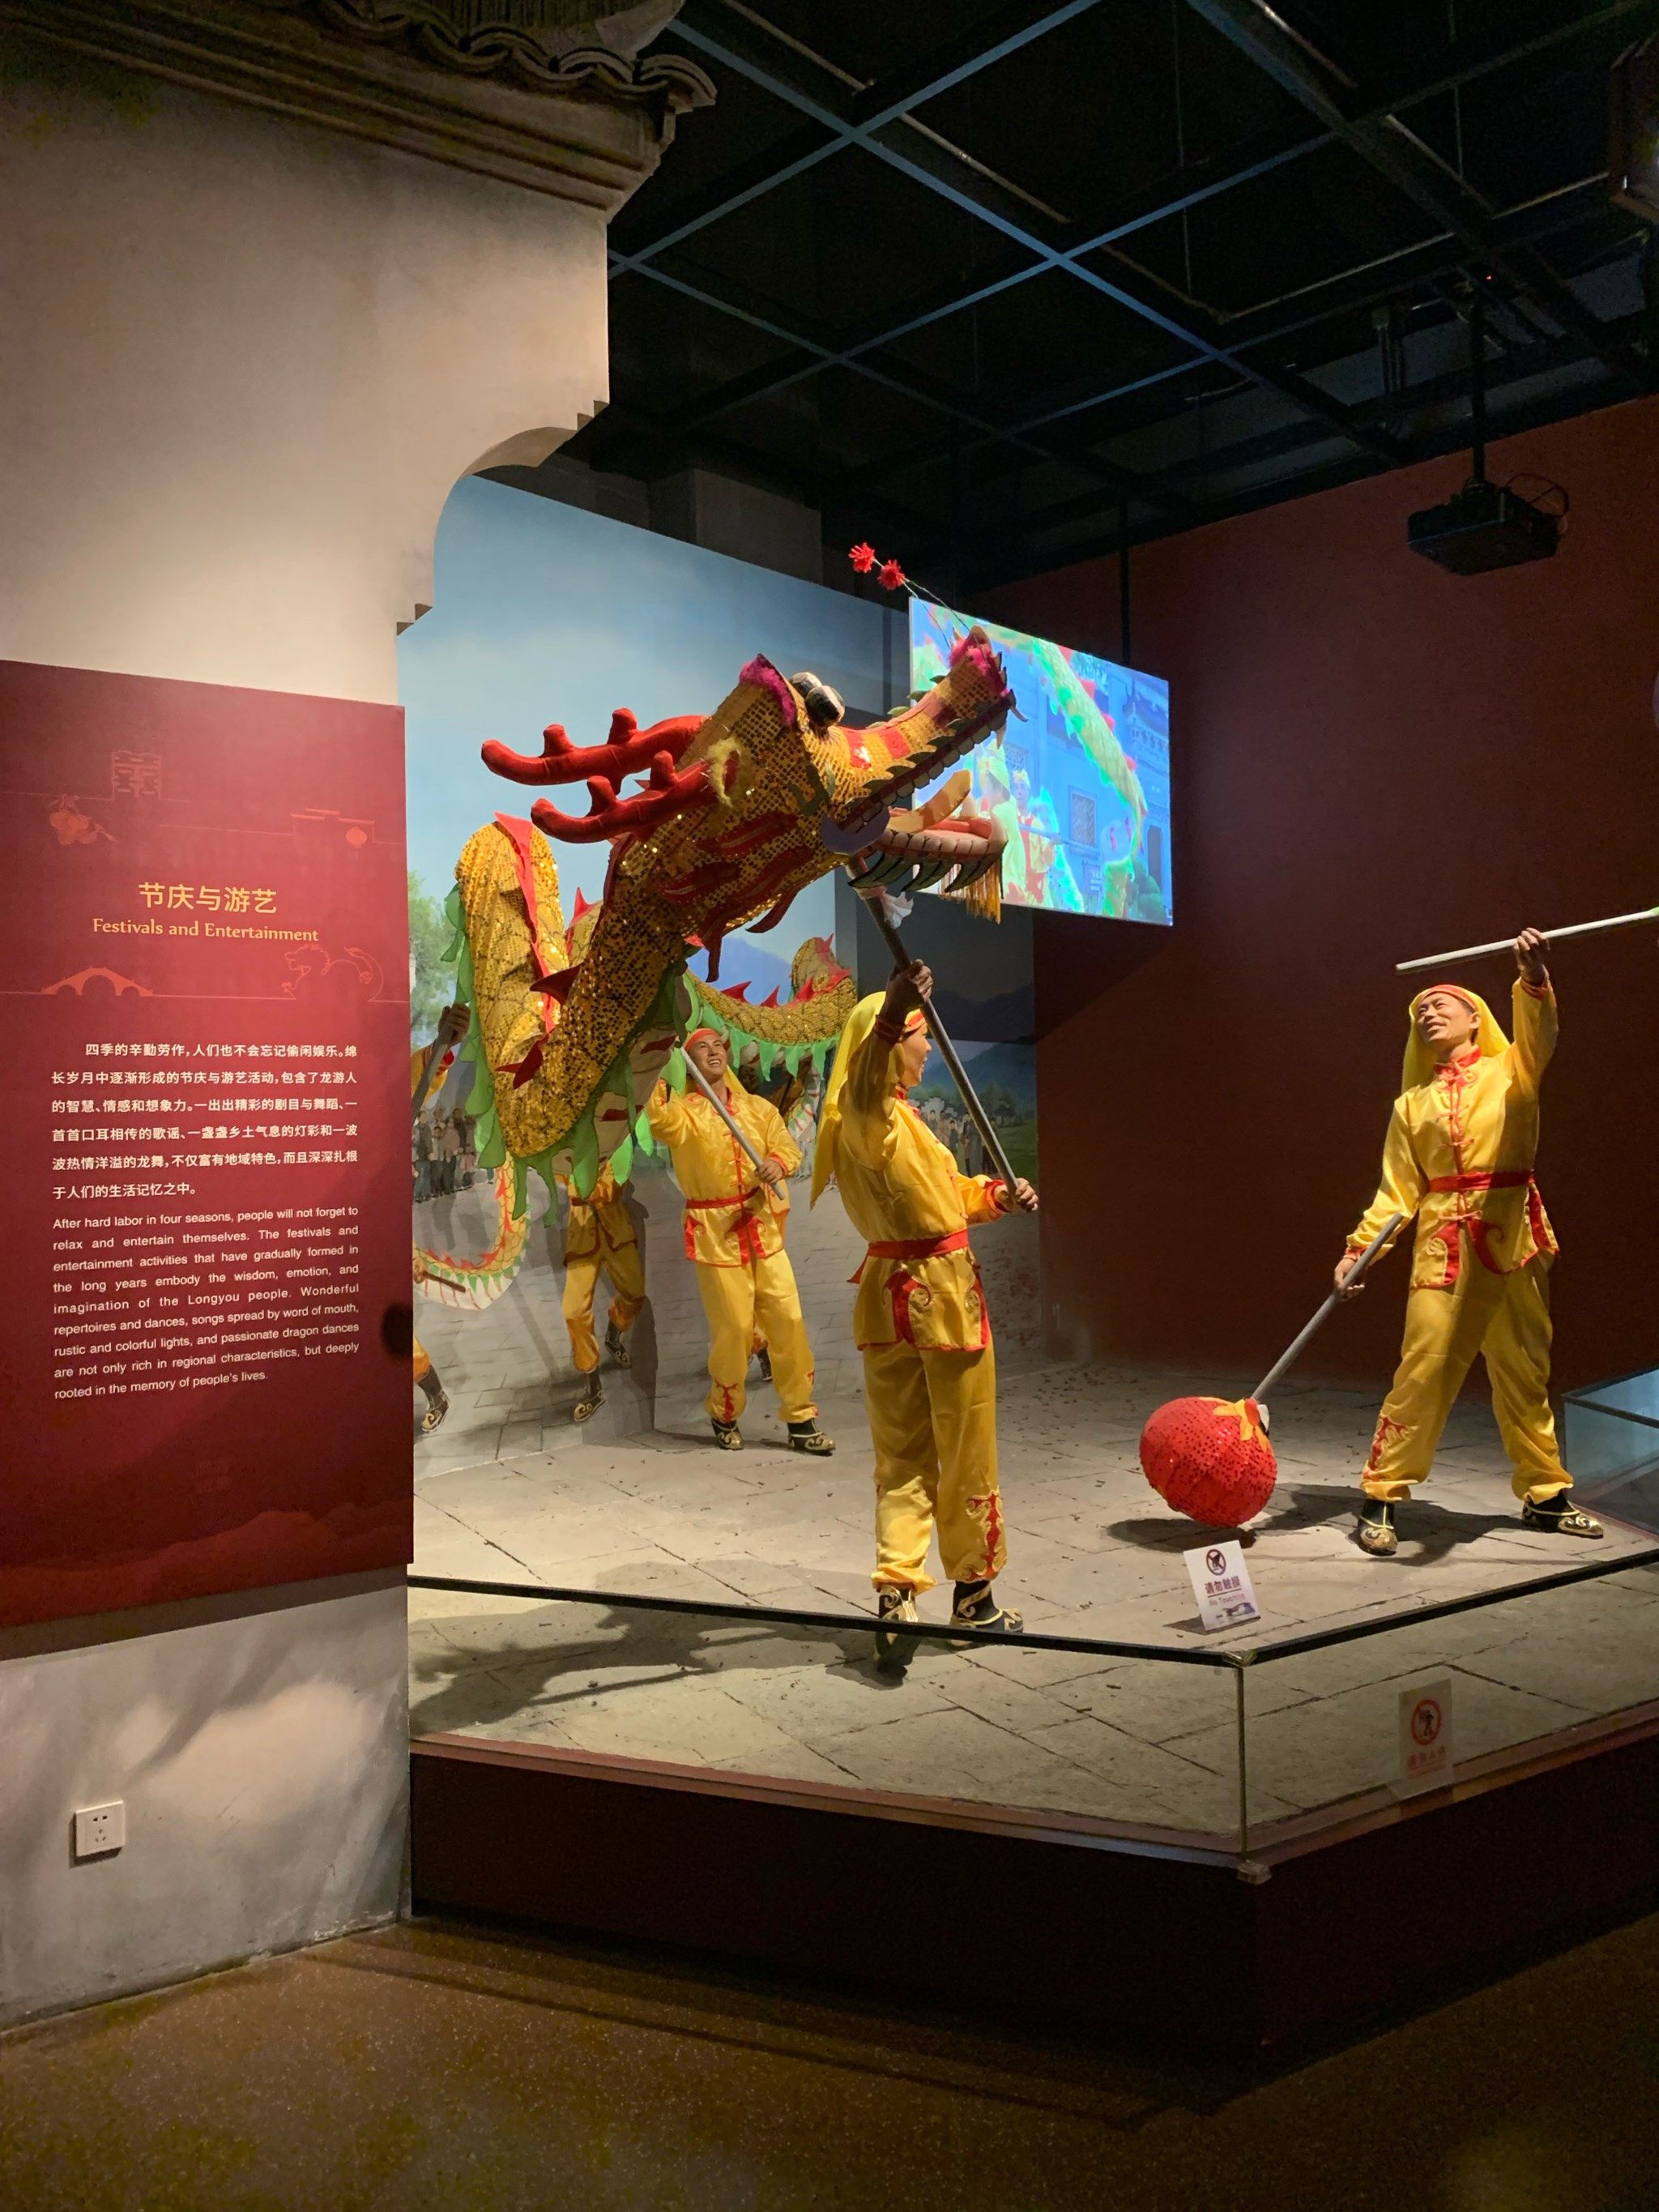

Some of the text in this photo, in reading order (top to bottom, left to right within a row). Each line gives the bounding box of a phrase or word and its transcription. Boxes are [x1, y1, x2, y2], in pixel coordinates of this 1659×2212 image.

[139, 882, 276, 913] 节庆与游艺
[93, 918, 318, 941] Festivals and Entertainment
[53, 1206, 358, 1228] After hard labor in four seasons, people will not forget to
[53, 1225, 358, 1250] relax and entertain themselves. The festivals and
[53, 1245, 358, 1271] entertainment activities that have gradually formed in
[53, 1264, 358, 1292] the long years embody the wisdom, emotion, and
[54, 1283, 359, 1315] imagination of the Longyou people. Wonderful
[54, 1303, 358, 1337] repertoires and dances, songs spread by word of mouth,
[54, 1324, 359, 1356] rustic and colorful lights, and passionate dragon dances
[54, 1342, 359, 1377] are not only rich in regional characteristics, but deeply
[54, 1372, 267, 1399] rooted in the memory of people's lives.
